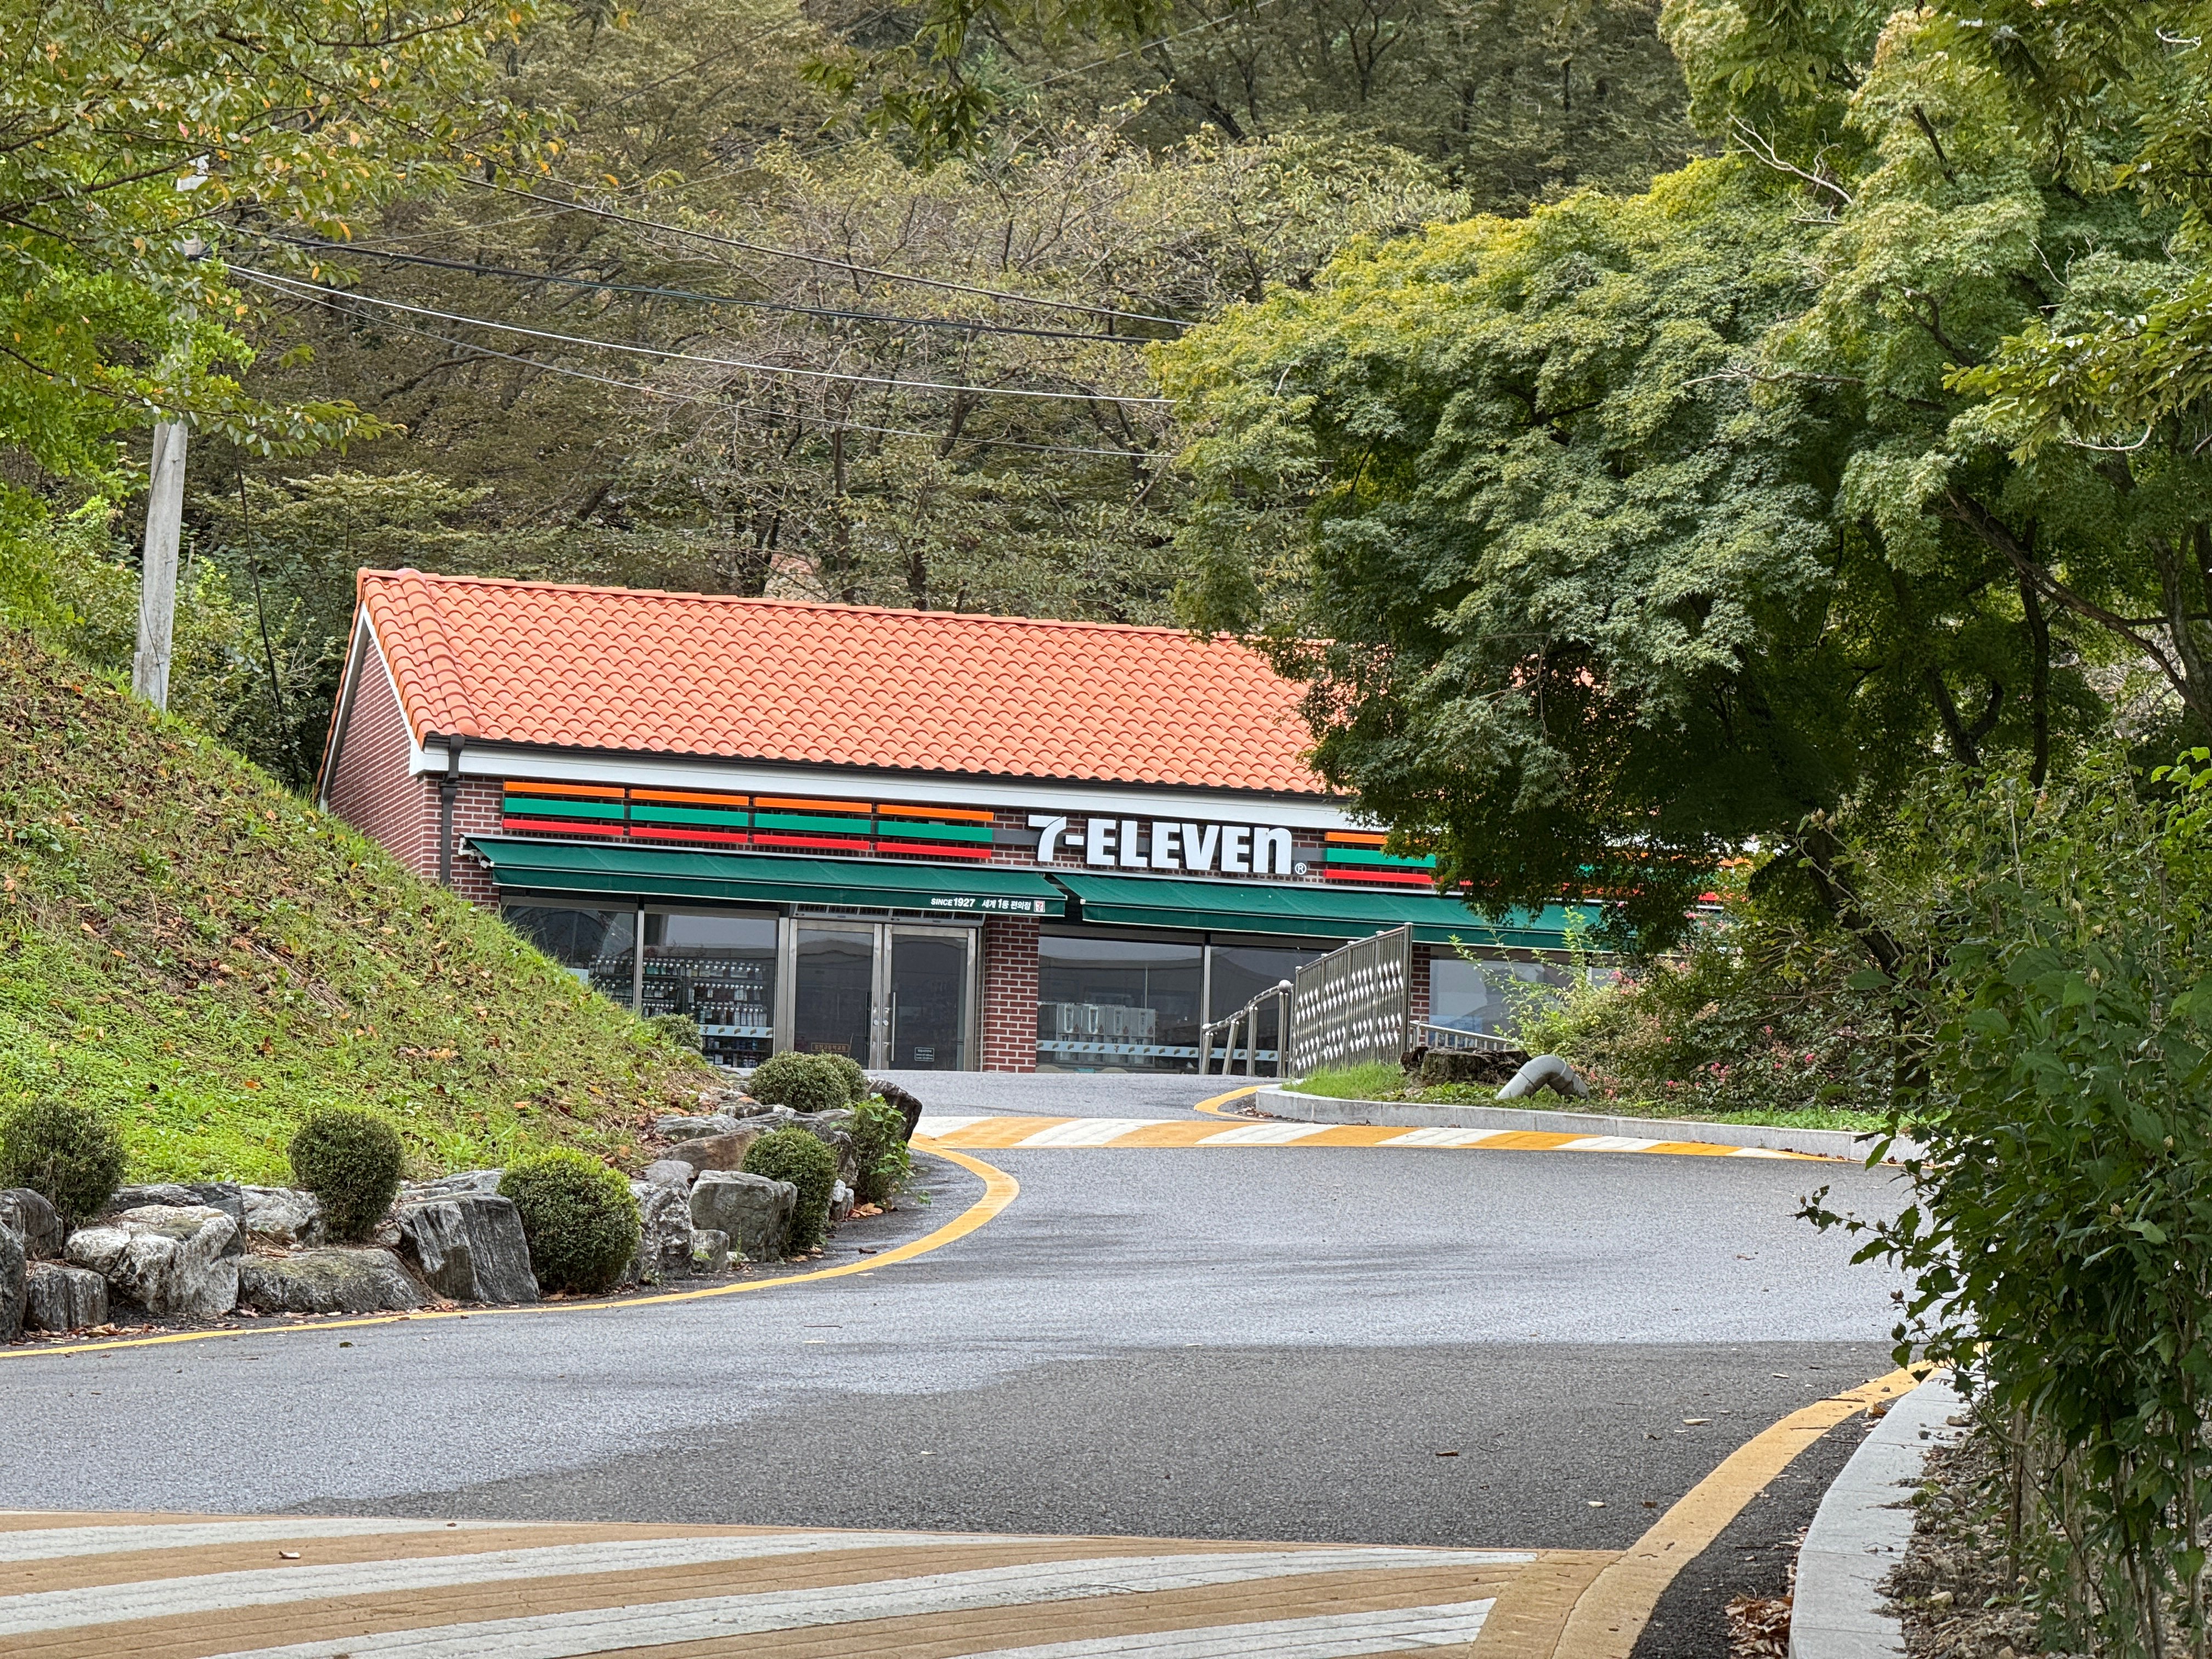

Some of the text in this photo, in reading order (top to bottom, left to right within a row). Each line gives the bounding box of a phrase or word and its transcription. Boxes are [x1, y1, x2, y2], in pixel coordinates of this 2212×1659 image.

[930, 898, 1031, 910] SINCE 1927 세계 1등 편의점
